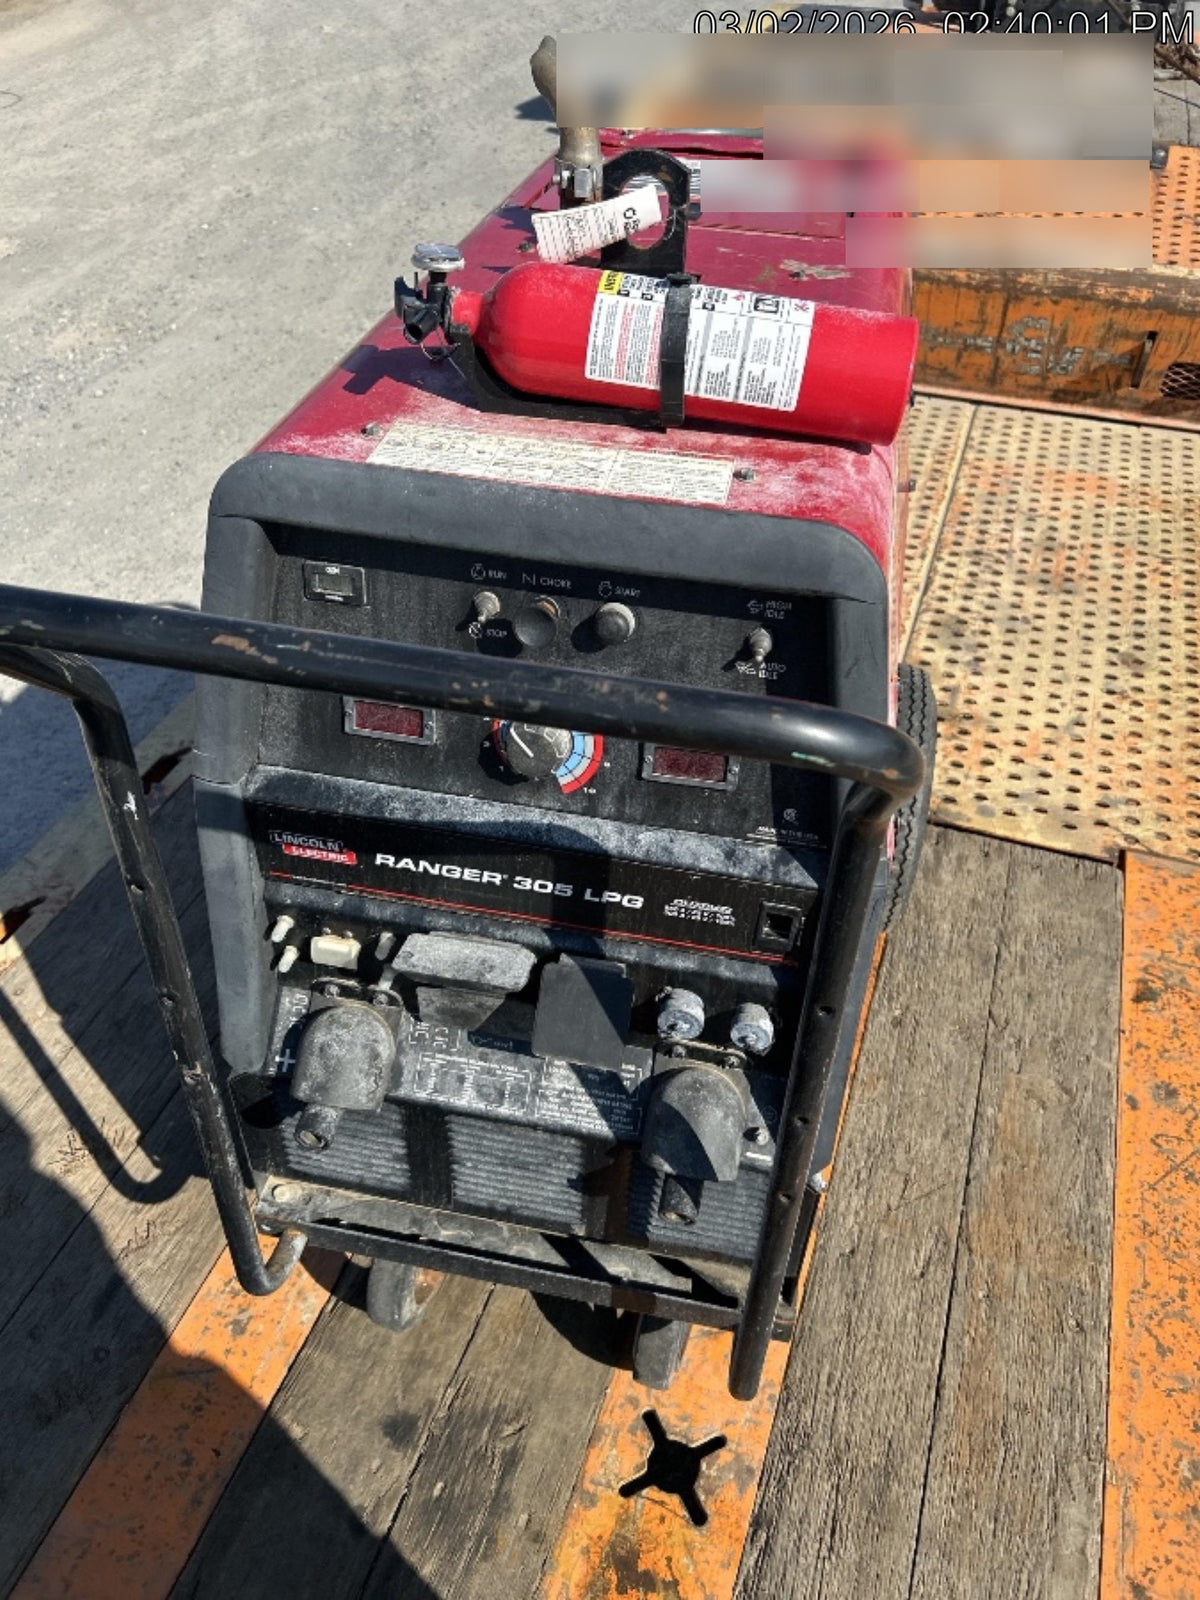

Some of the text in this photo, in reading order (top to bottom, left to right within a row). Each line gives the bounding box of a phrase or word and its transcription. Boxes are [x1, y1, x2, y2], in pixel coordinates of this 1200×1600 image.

[488, 569, 507, 579] RUN
[540, 577, 572, 589] CHOKE
[614, 586, 641, 598] START
[274, 832, 341, 852] LINCOLN
[290, 845, 349, 862] ELECTRIC
[512, 875, 574, 898] 305
[583, 887, 645, 910] LPG
